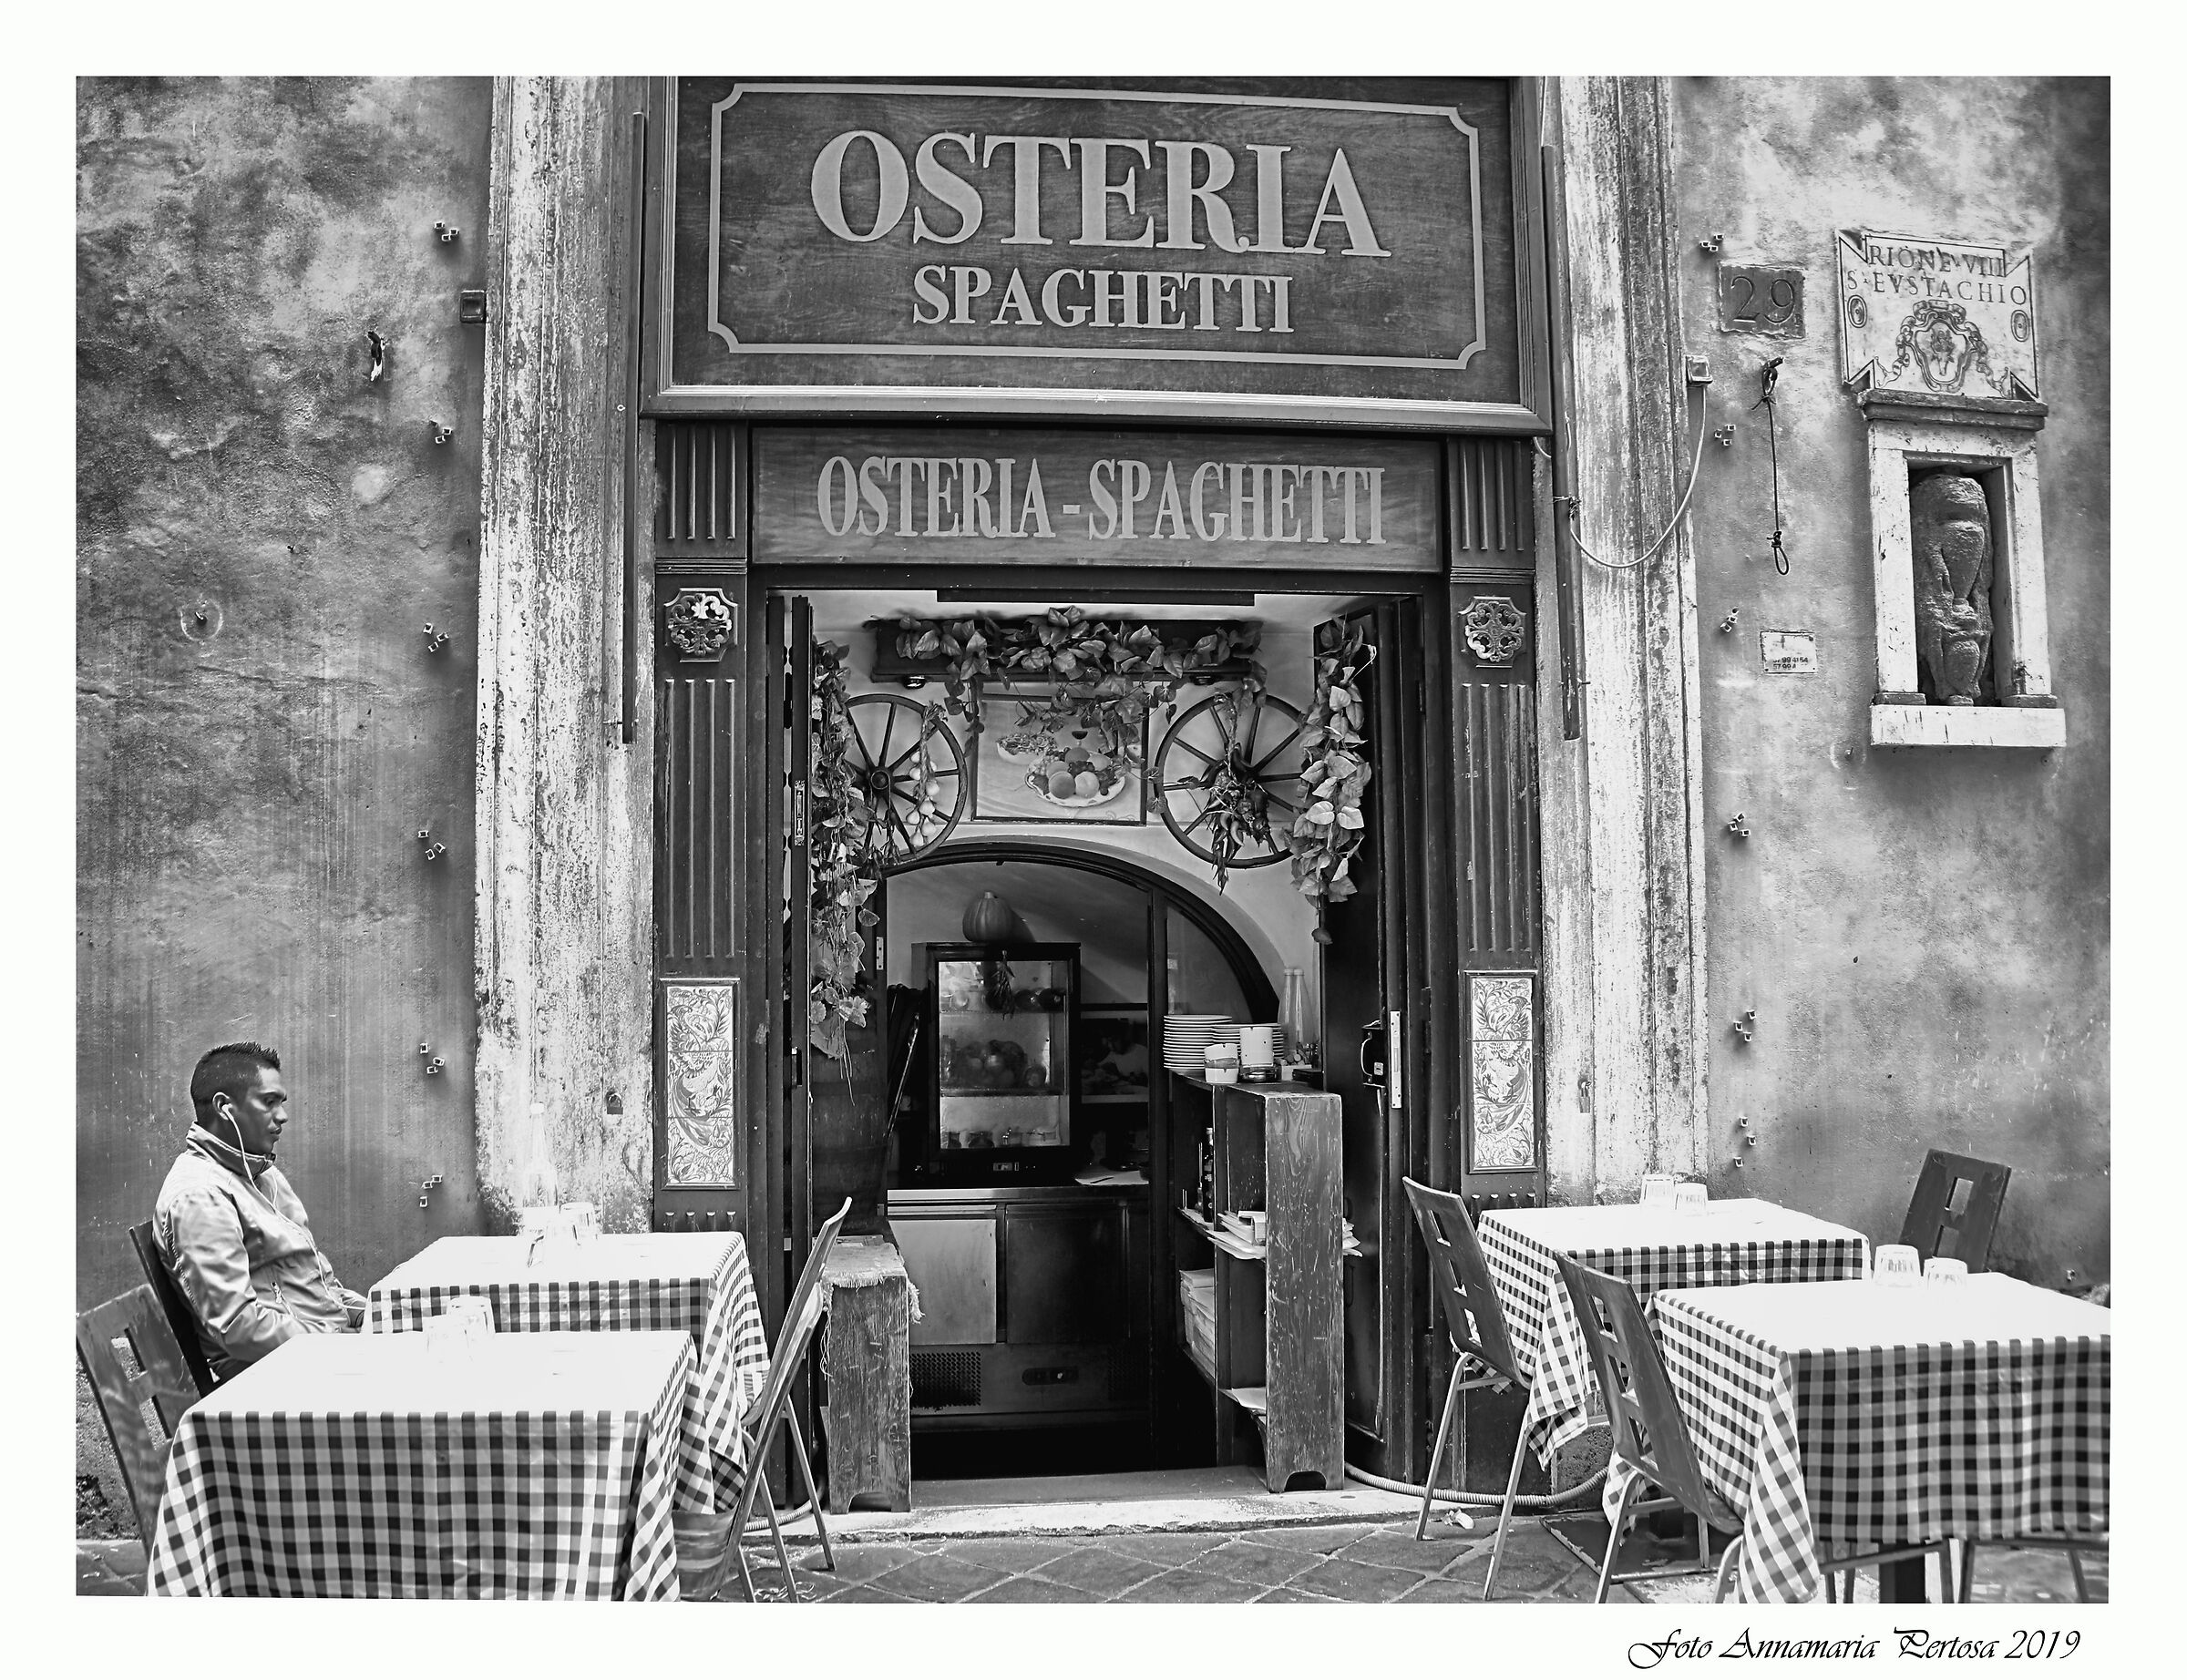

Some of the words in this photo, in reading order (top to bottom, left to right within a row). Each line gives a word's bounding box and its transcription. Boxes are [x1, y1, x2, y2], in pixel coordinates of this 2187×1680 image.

[810, 129, 1392, 259] OSTERIA
[912, 264, 1296, 333] SPAGHETTI
[1730, 276, 1795, 325] 29
[816, 455, 1057, 540] OSTERIA
[1088, 457, 1386, 546] SPAGHETTI
